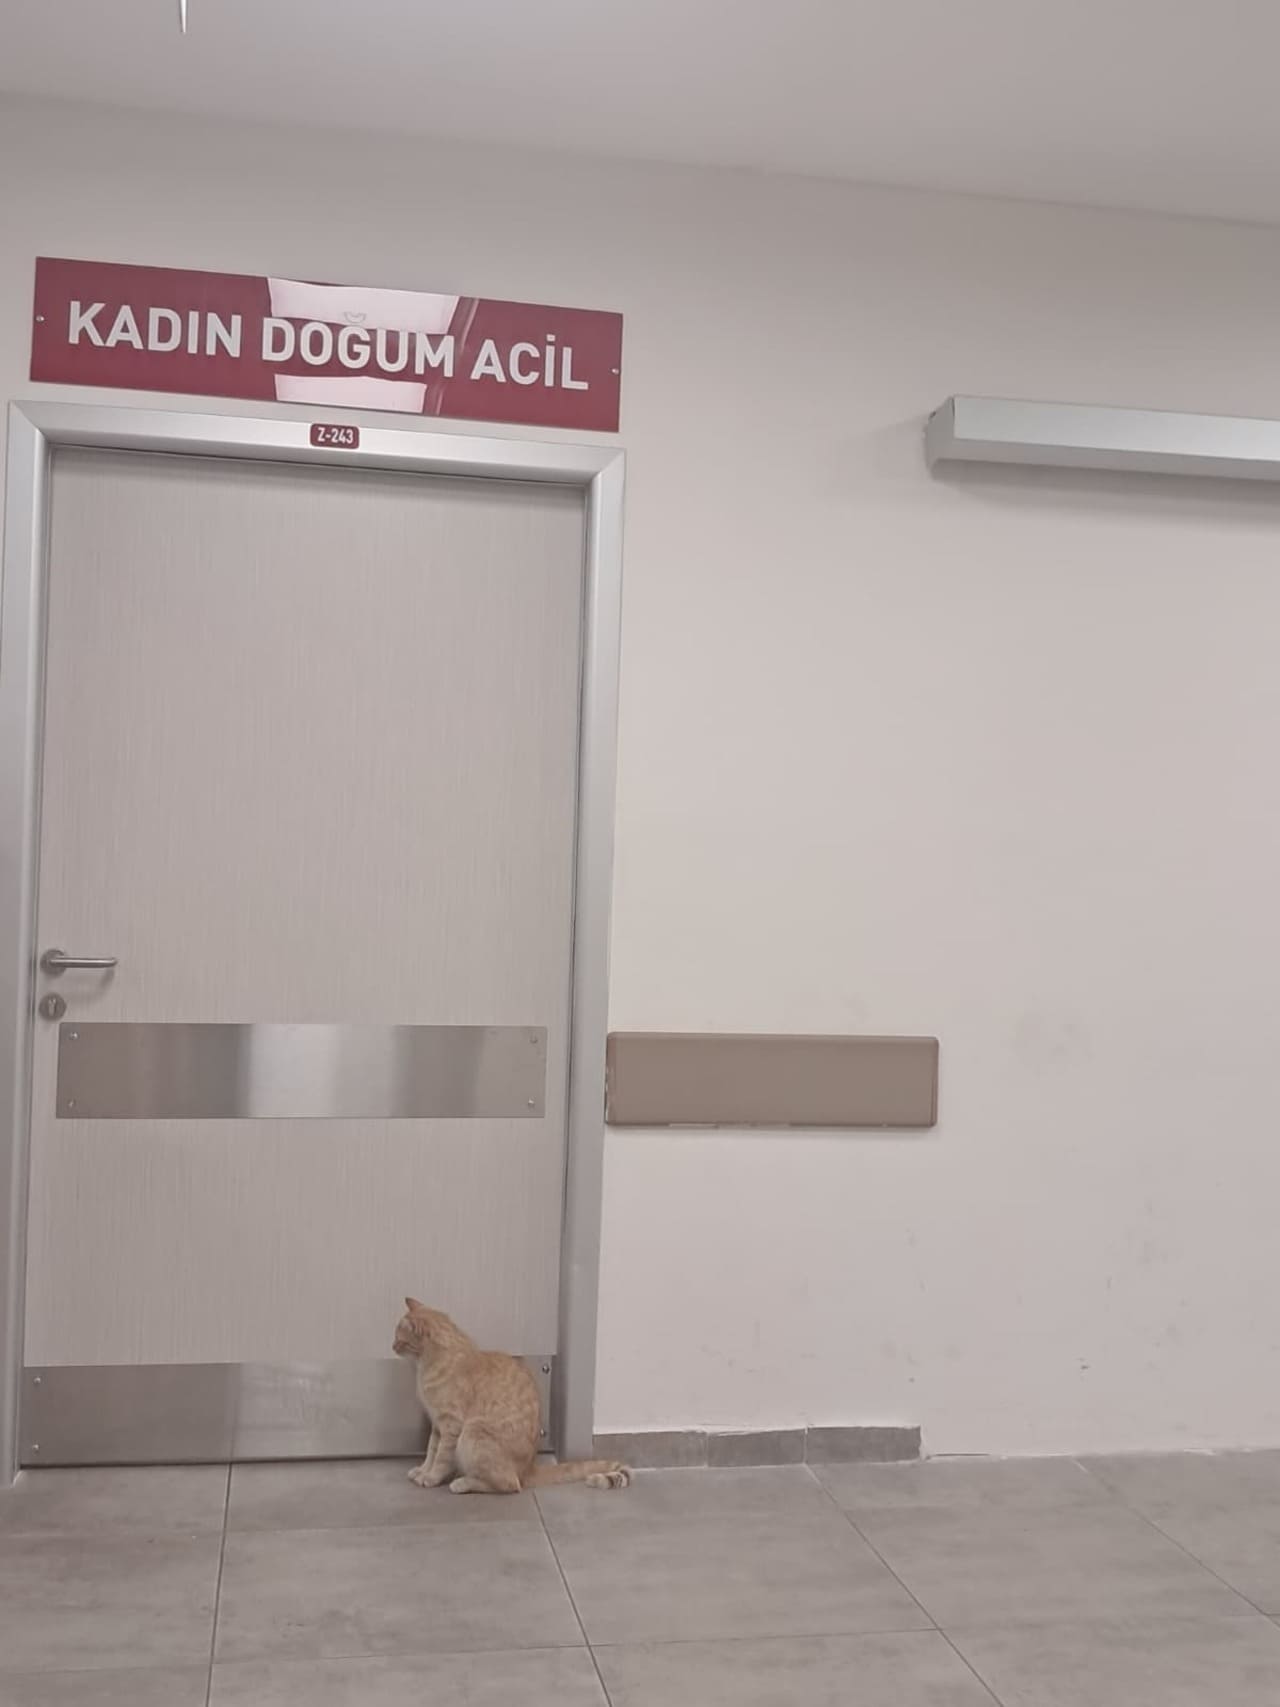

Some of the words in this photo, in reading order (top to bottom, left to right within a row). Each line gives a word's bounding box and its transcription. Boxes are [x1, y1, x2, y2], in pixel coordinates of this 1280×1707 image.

[68, 300, 242, 358] KADIN
[262, 312, 455, 378] DOĞUM
[470, 334, 589, 390] ACİL
[317, 427, 354, 444] Z-243
